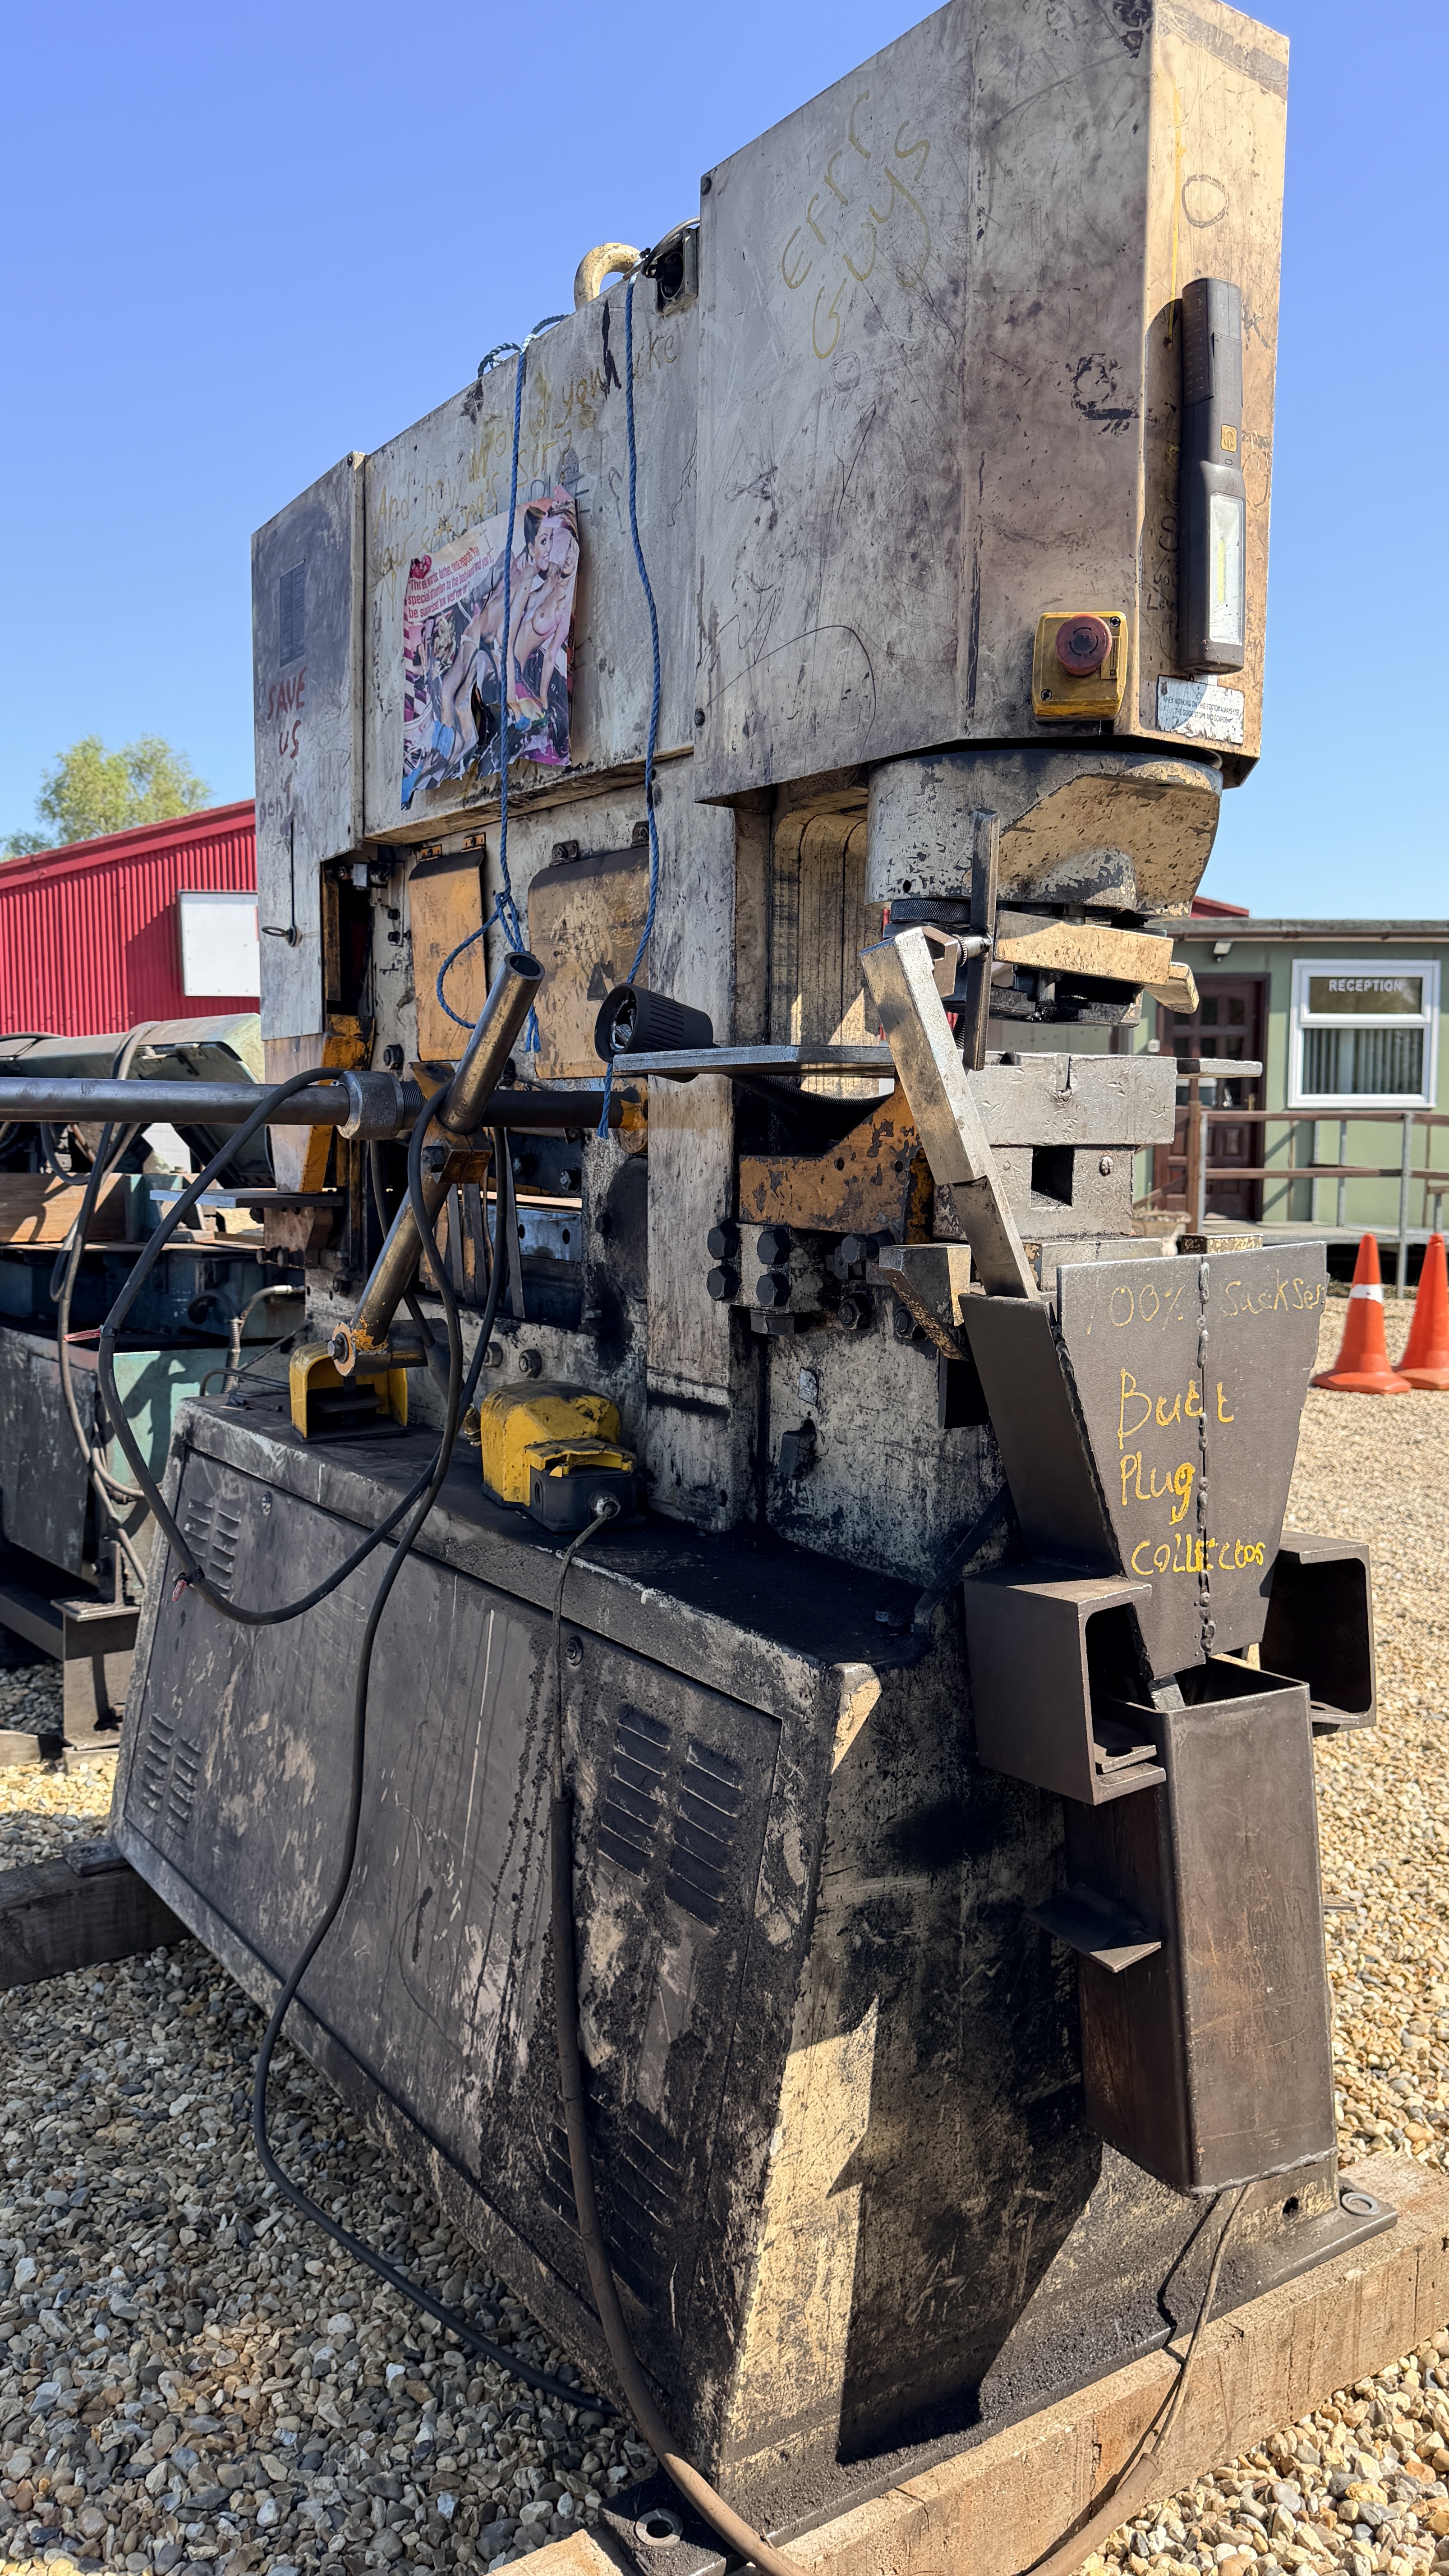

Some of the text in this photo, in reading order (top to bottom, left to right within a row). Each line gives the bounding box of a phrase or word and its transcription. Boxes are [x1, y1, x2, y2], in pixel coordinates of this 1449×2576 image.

[409, 607, 419, 619] be
[267, 666, 308, 721] SAVE
[279, 719, 301, 760] US
[1329, 979, 1404, 992] RECEPTION
